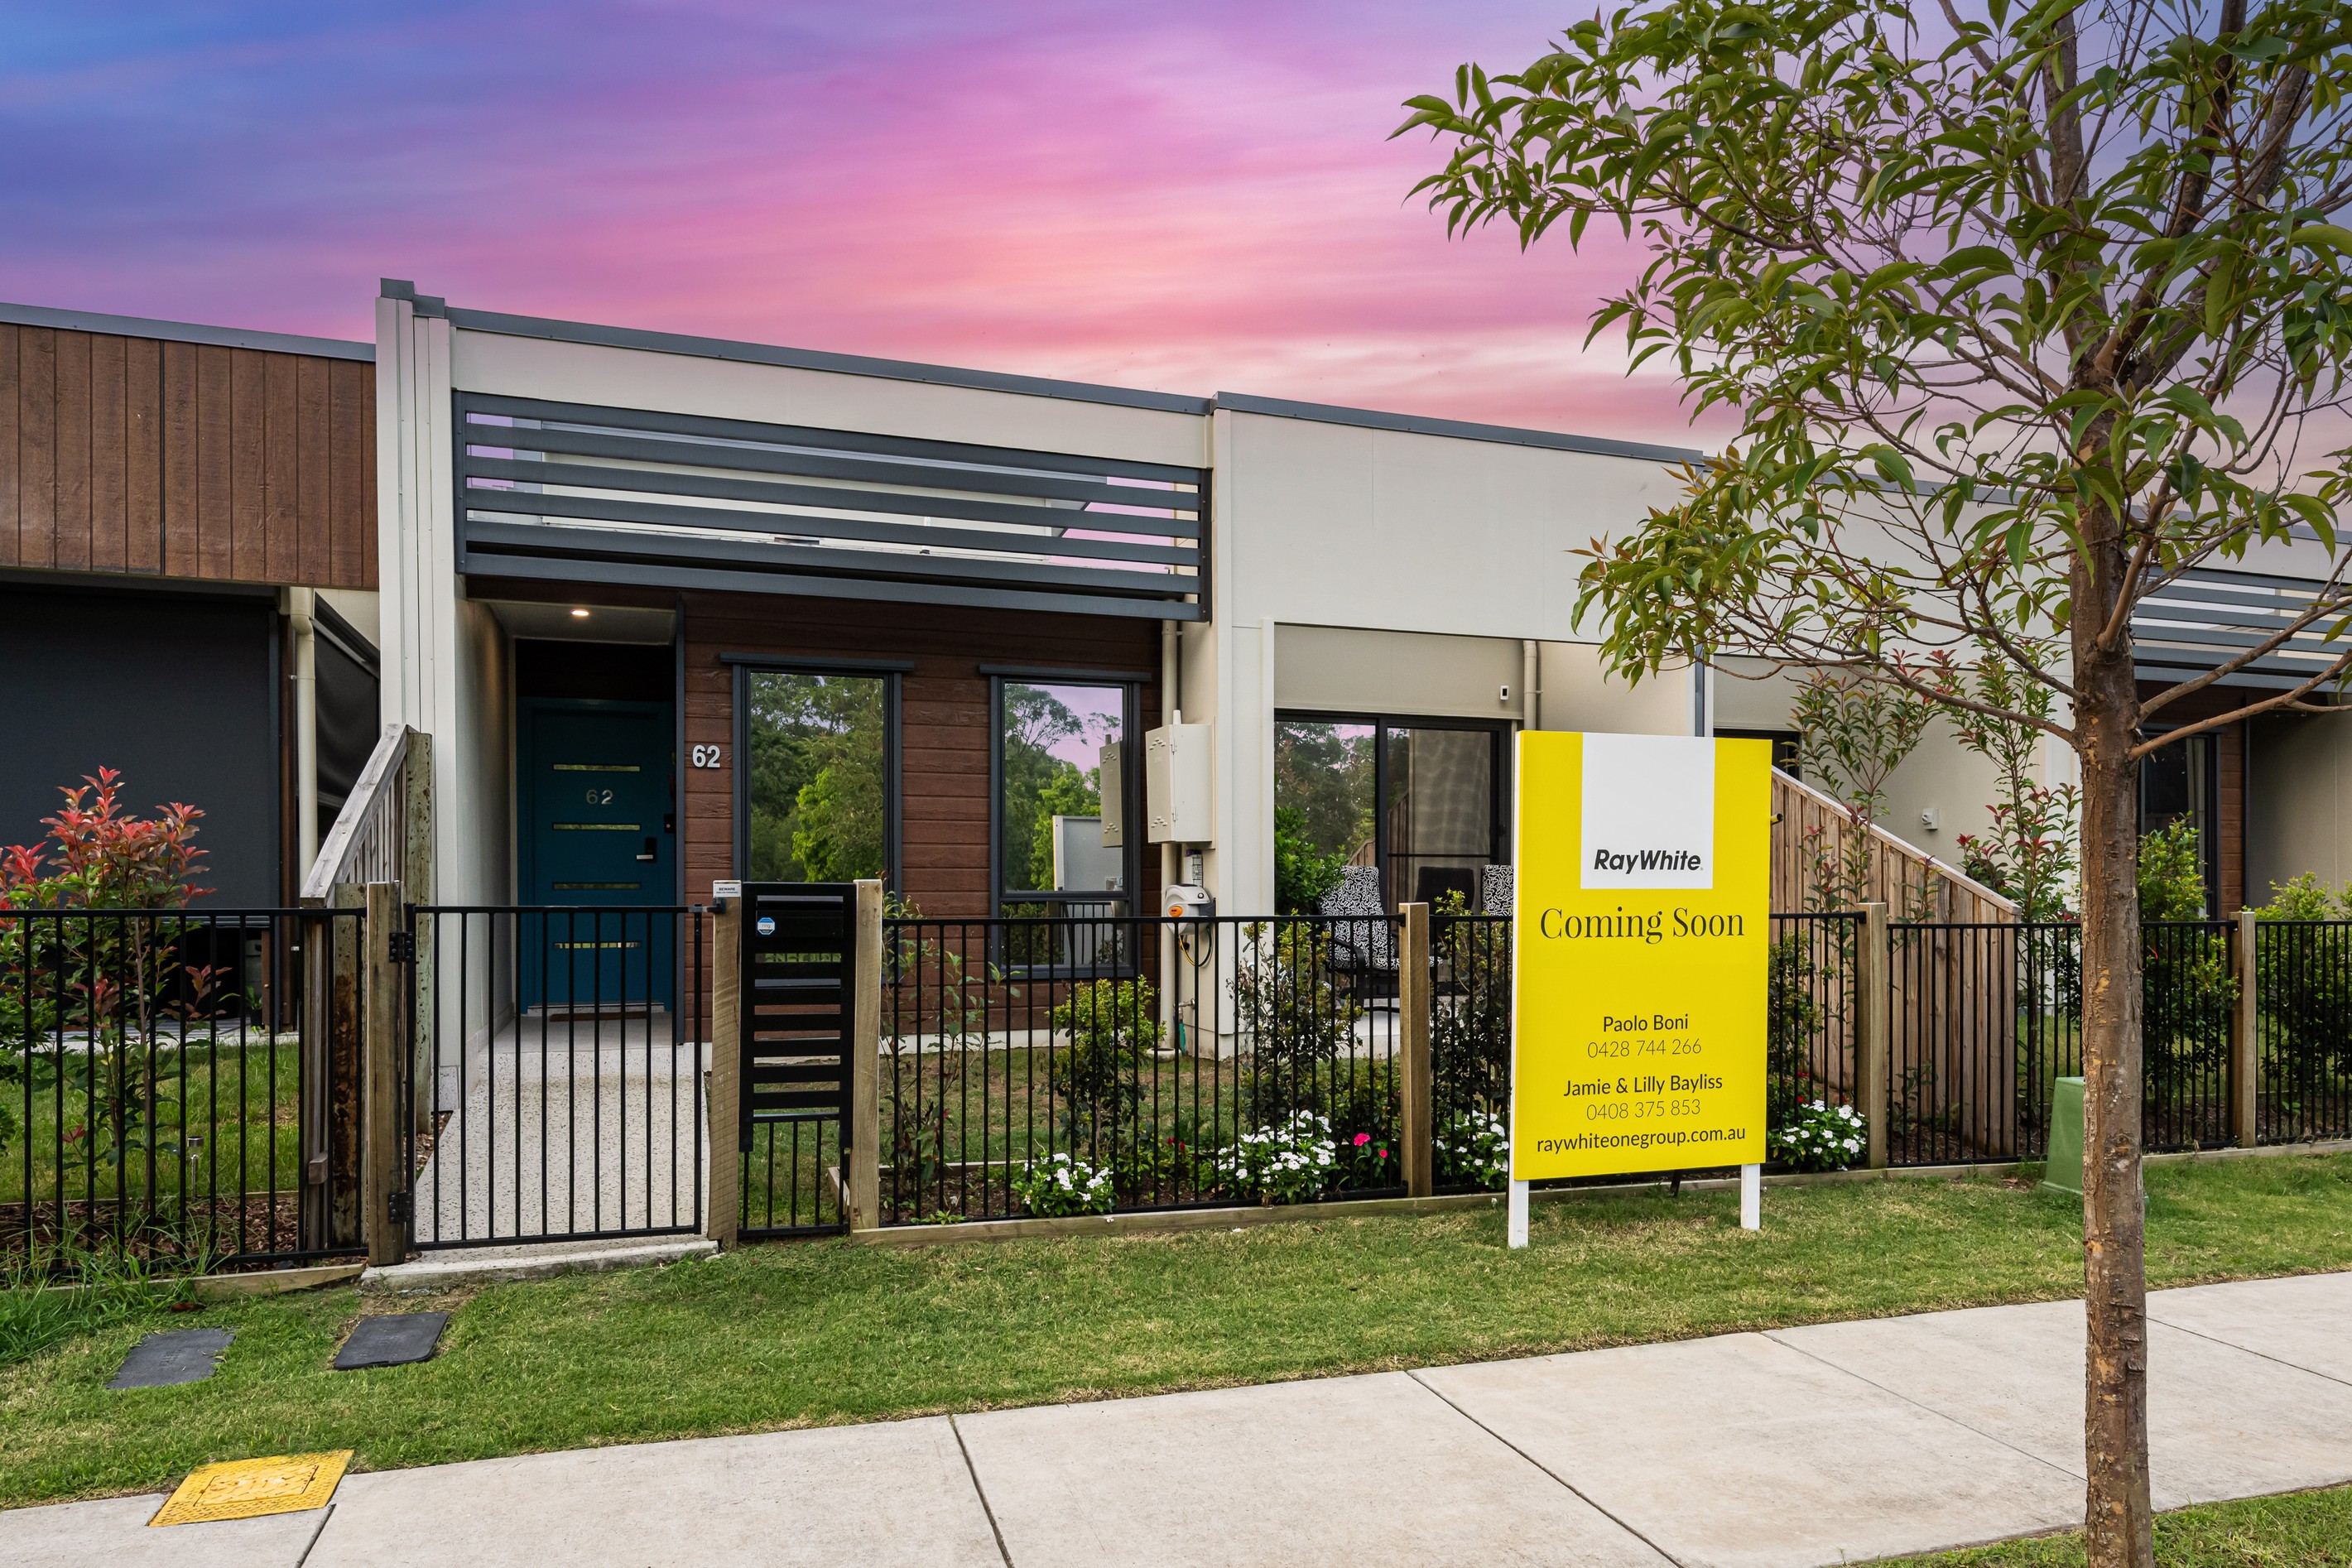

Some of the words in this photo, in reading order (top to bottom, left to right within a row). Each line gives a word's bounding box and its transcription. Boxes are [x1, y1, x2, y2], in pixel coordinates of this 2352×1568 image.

[692, 745, 720, 768] 62
[586, 789, 613, 805] 62
[1593, 849, 1701, 875] RayWhite
[1540, 906, 1663, 945] Coming
[1672, 907, 1744, 938] Soon
[1603, 1014, 1648, 1032] Paolo
[1653, 1013, 1689, 1031] Boni
[1587, 1041, 1630, 1058] 0428
[1636, 1040, 1665, 1056] 744
[1671, 1038, 1702, 1055] 266
[1563, 1077, 1611, 1097] Jamie
[1616, 1077, 1628, 1094] &
[1634, 1075, 1666, 1095] Lilly
[1670, 1074, 1723, 1094] Bayliss
[1585, 1104, 1628, 1121] 0408
[1634, 1101, 1665, 1118] 375
[1671, 1099, 1700, 1116] 853
[1537, 1126, 1746, 1153] raywhiteonegroup.com.au
